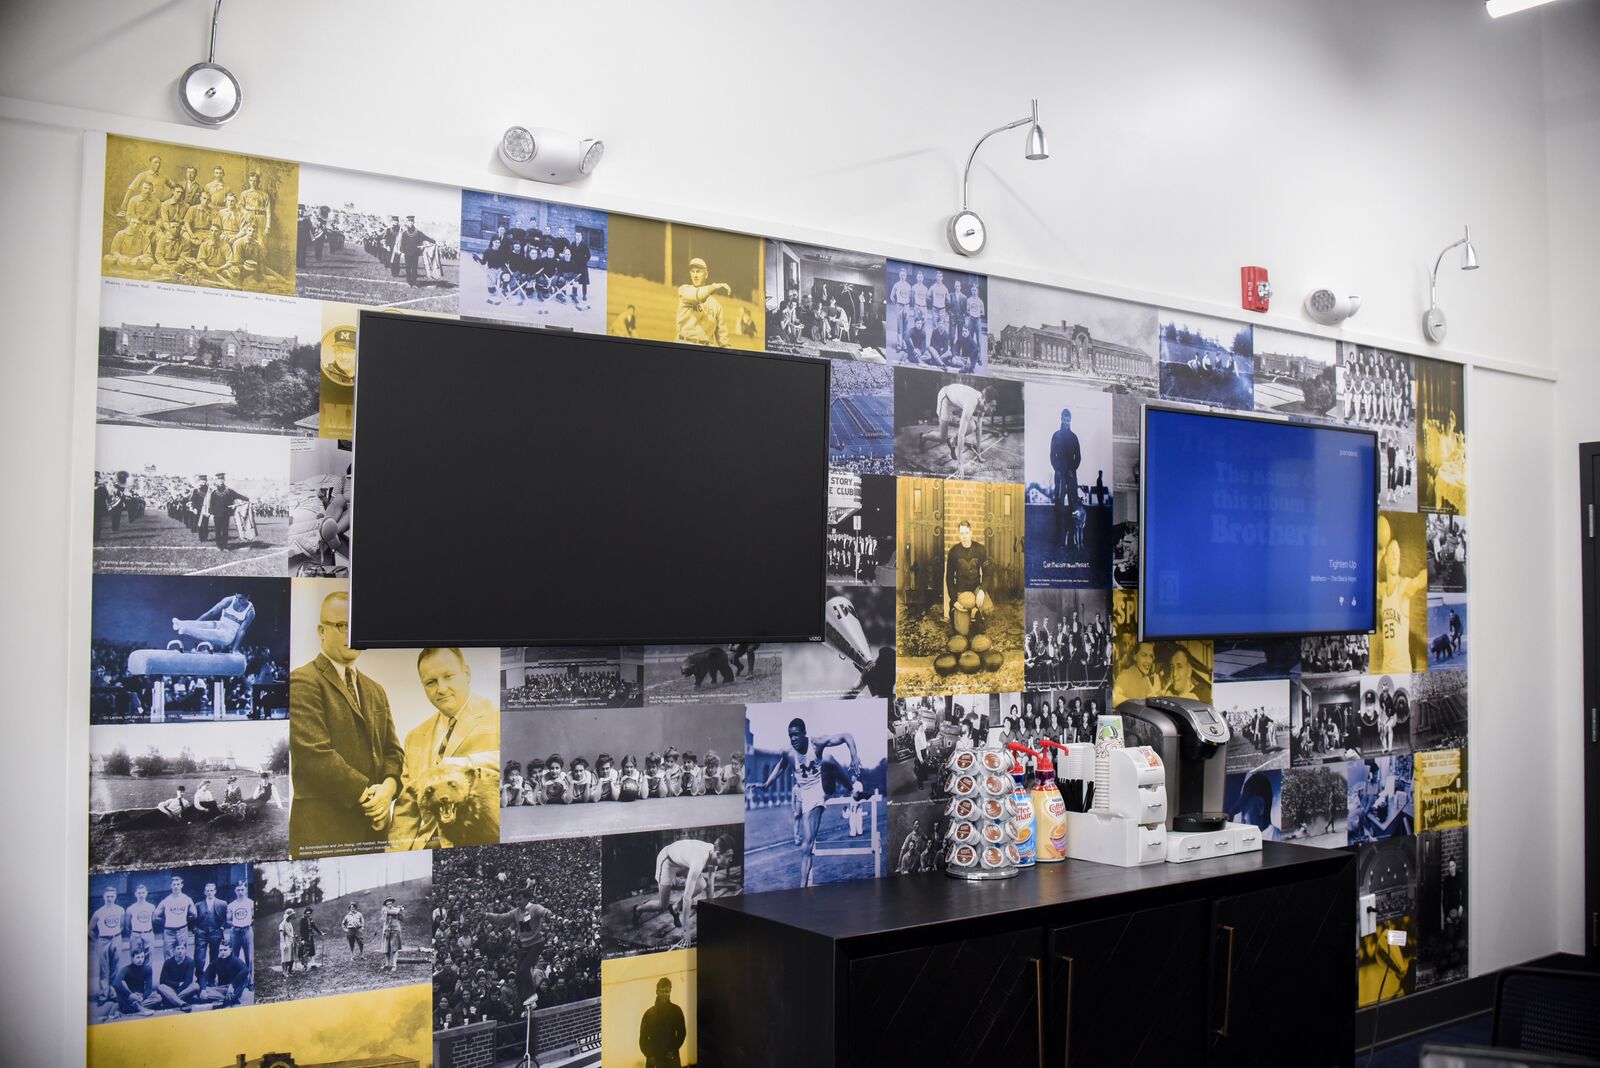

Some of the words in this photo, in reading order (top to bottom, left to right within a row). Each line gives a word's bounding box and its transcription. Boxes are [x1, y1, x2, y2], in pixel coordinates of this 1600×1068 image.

[340, 331, 351, 341] M
[830, 476, 853, 486] STORY
[836, 487, 854, 496] CLUB
[1328, 559, 1348, 570] Tighten
[1348, 560, 1358, 571] Up
[1384, 622, 1395, 639] 25
[799, 760, 819, 779] M
[1015, 812, 1031, 822] mate
